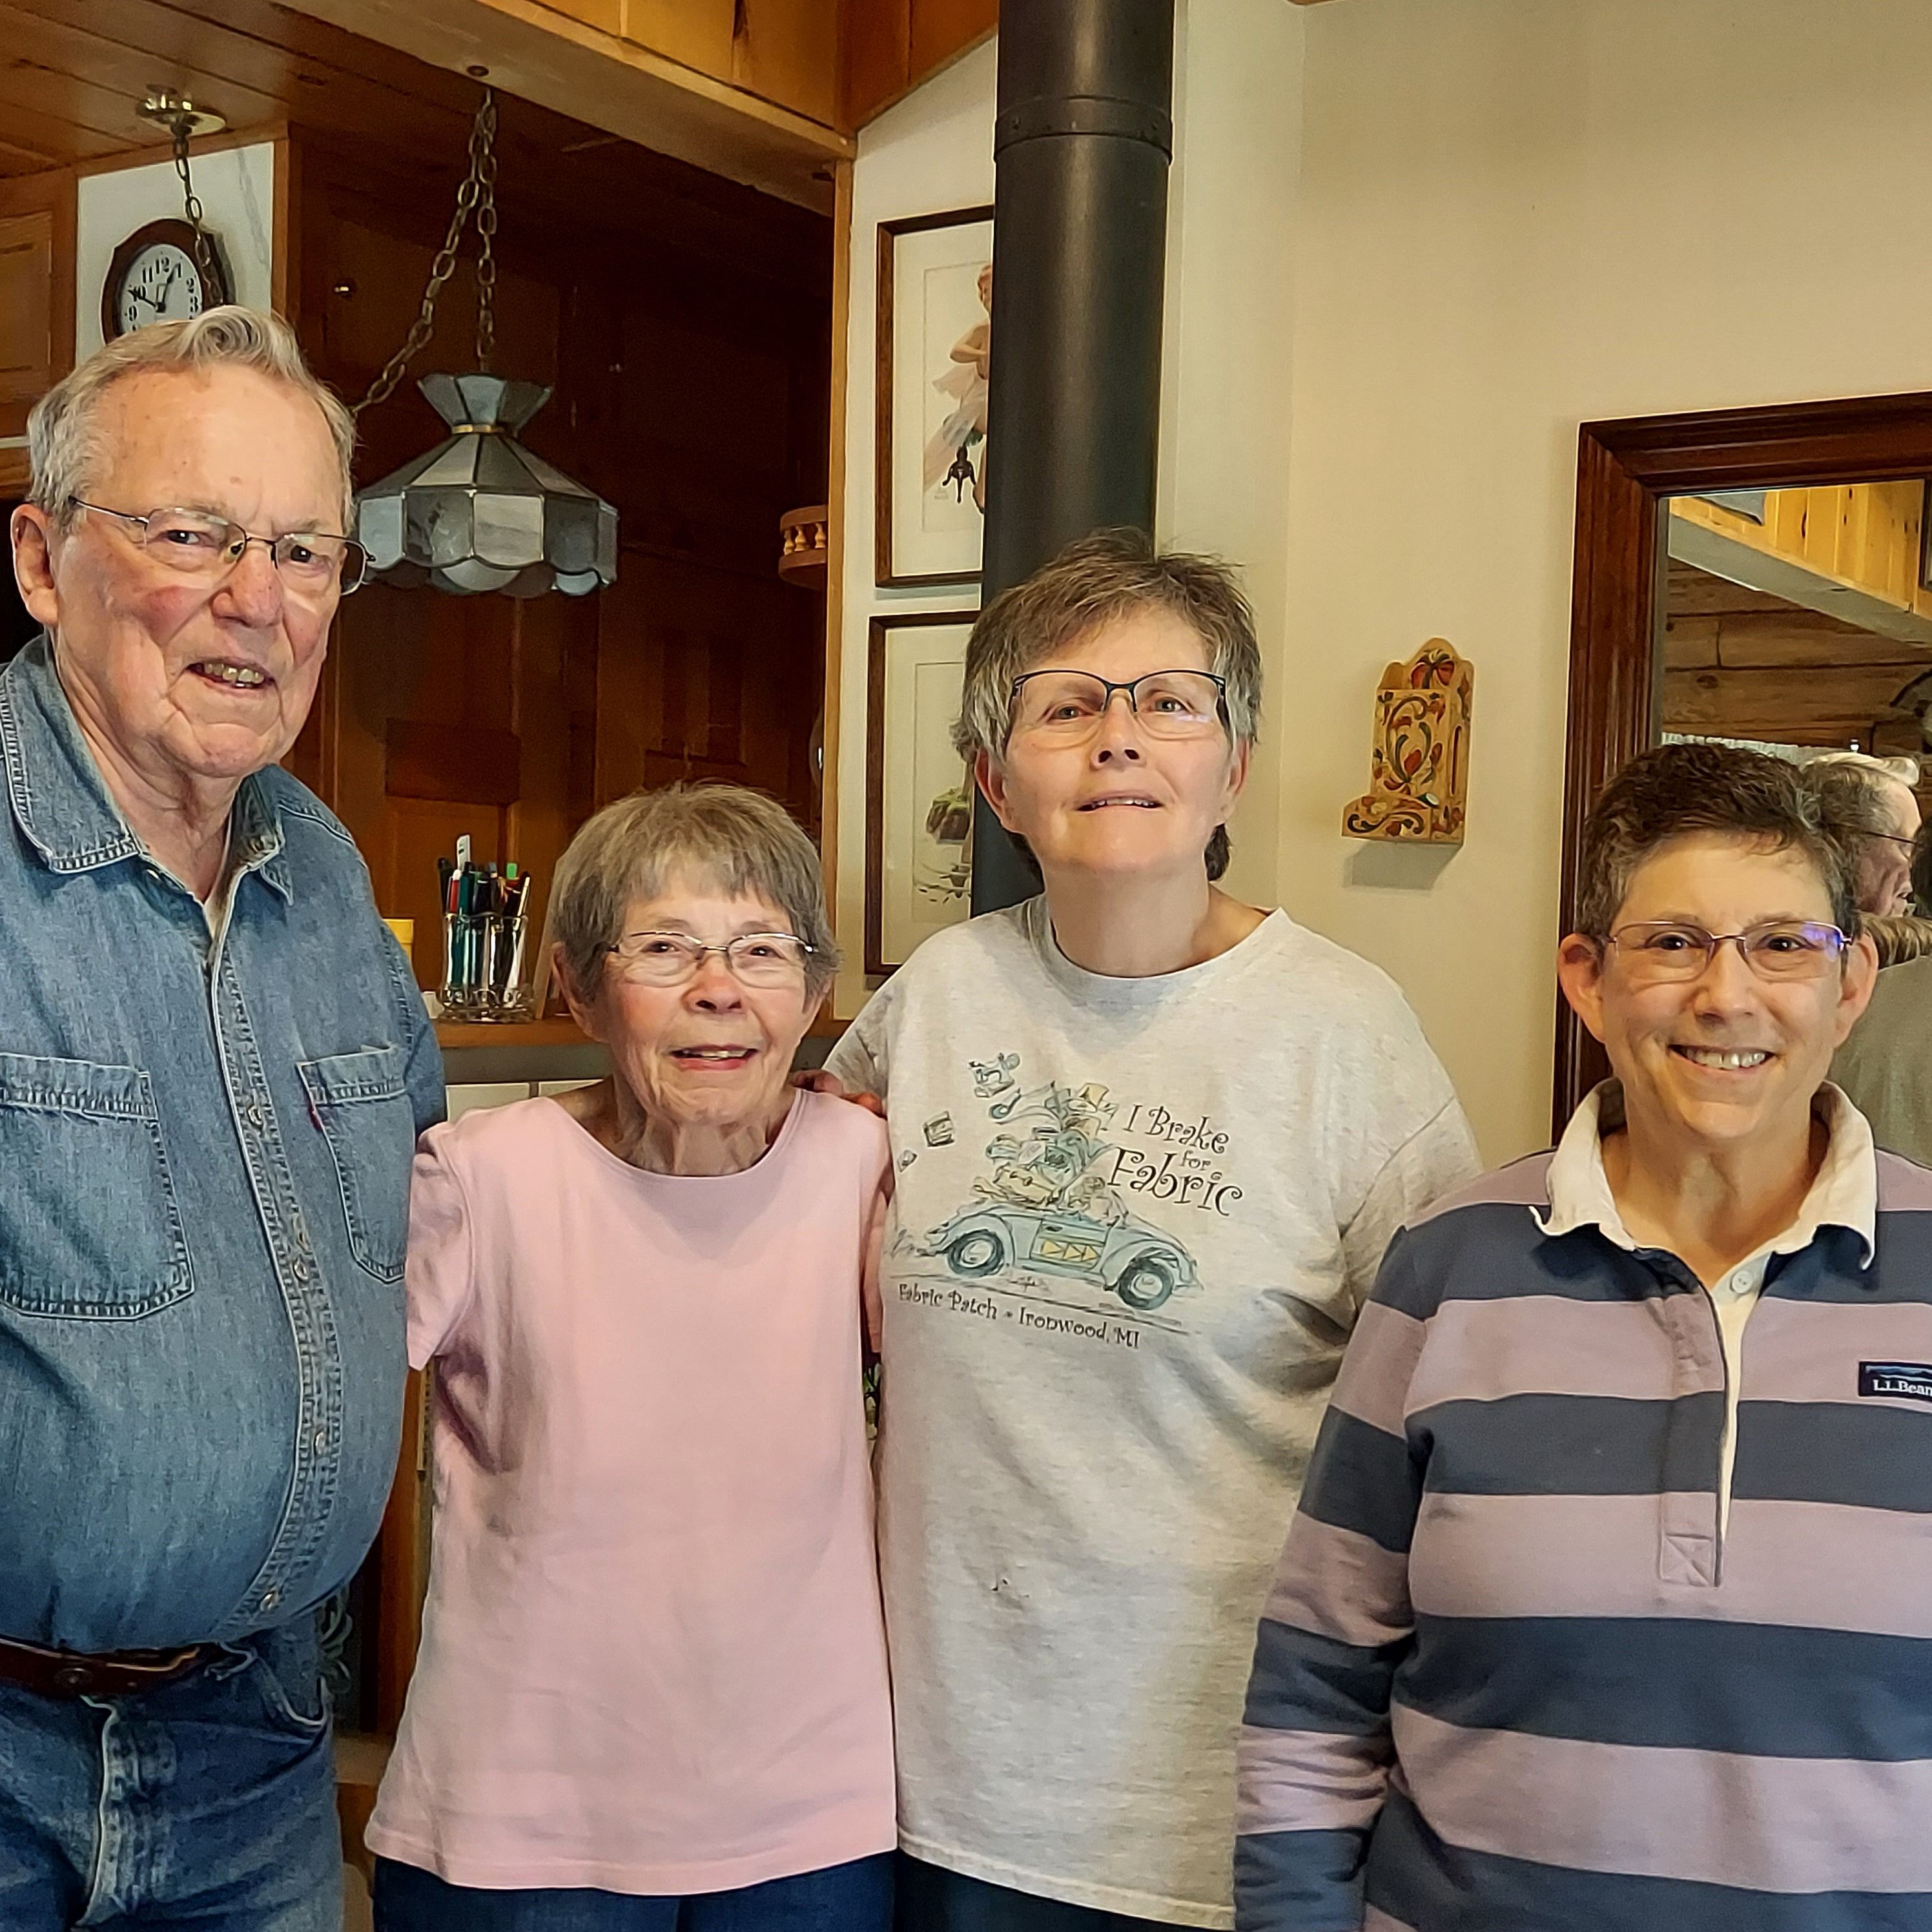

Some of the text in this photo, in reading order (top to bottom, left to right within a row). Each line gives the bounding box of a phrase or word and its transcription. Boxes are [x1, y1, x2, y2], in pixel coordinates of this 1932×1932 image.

[156, 257, 170, 274] 12
[186, 278, 194, 294] 2
[129, 305, 138, 322] 9
[190, 296, 198, 313] 3
[1122, 1104, 1229, 1154] I Brake
[1180, 1149, 1211, 1171] for
[1107, 1146, 1243, 1217] Fabric
[899, 1282, 943, 1307] Fabric
[947, 1289, 998, 1320] Patch
[1018, 1300, 1109, 1343] Ironwood,
[1113, 1321, 1140, 1350] MI
